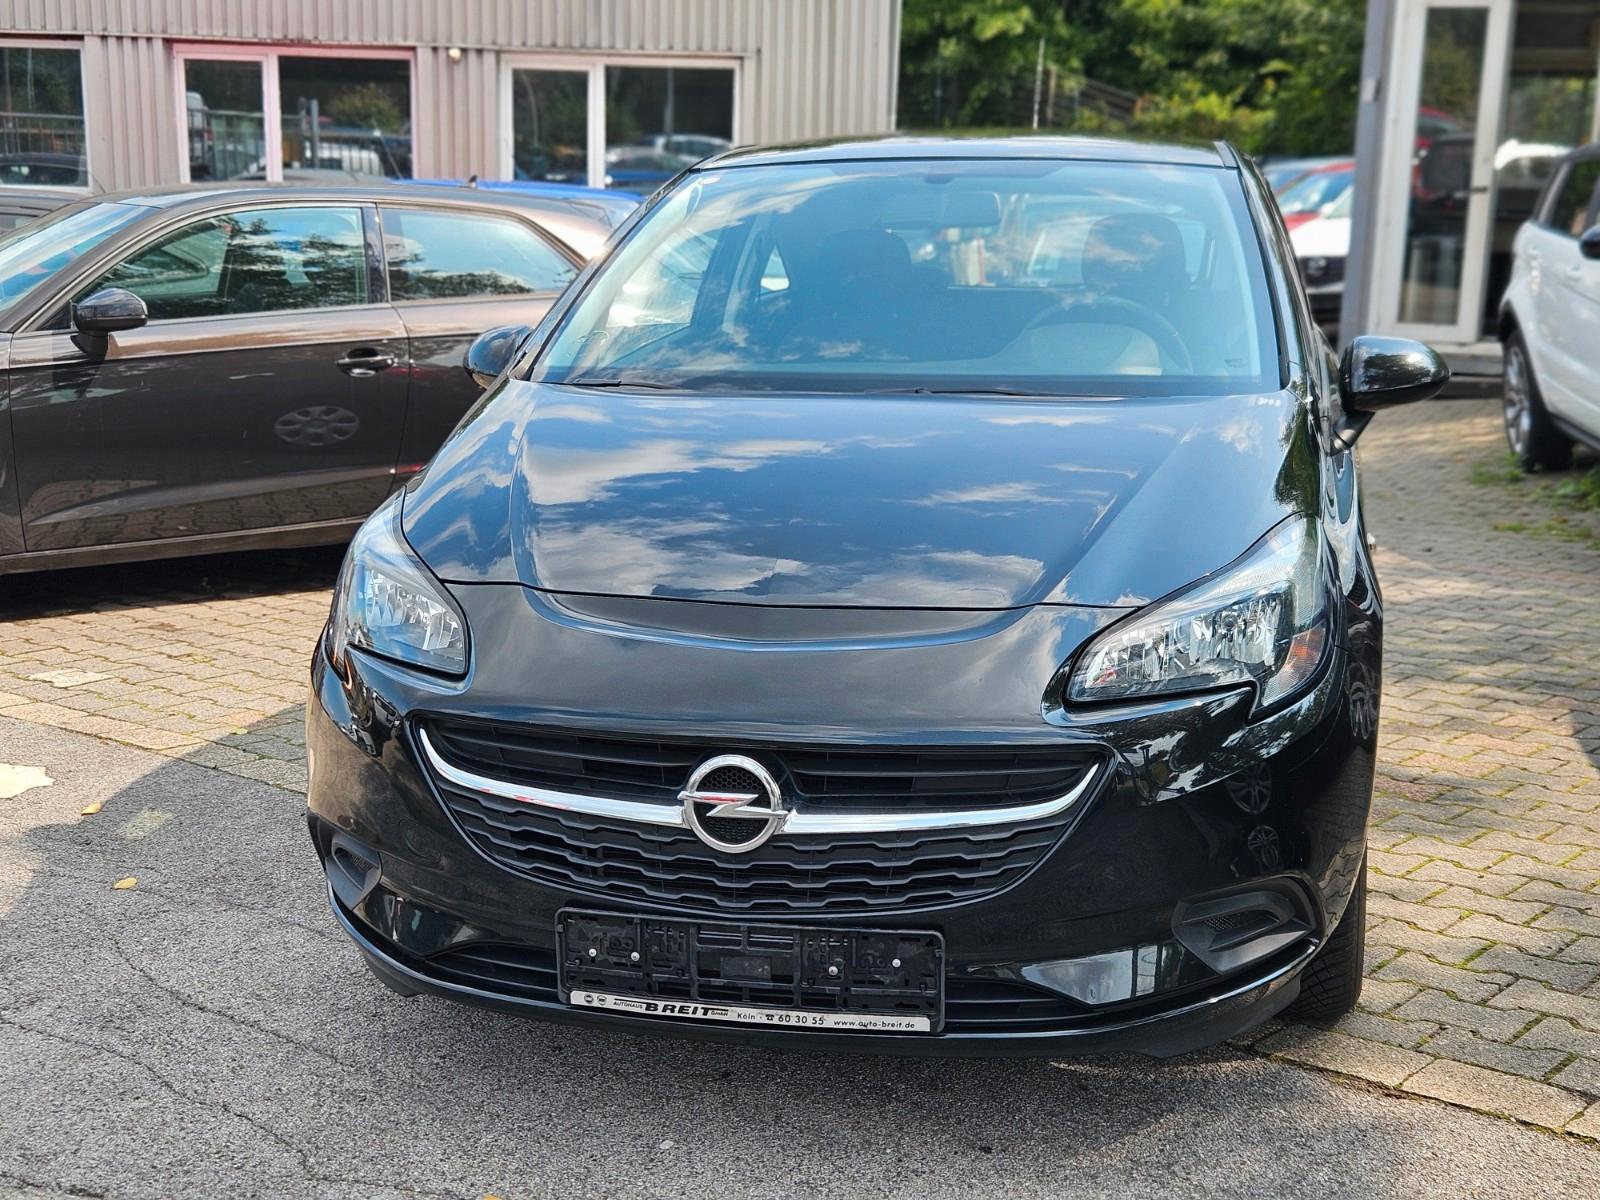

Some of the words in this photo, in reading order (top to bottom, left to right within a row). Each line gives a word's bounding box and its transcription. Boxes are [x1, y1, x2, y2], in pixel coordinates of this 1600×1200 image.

[613, 1001, 643, 1010] AUTOHAUS
[644, 1002, 711, 1017] BREIT
[777, 1014, 791, 1024] 60
[794, 1015, 808, 1025] 30
[811, 1016, 825, 1026] 55
[833, 1019, 915, 1029] www.auto-breit.de
